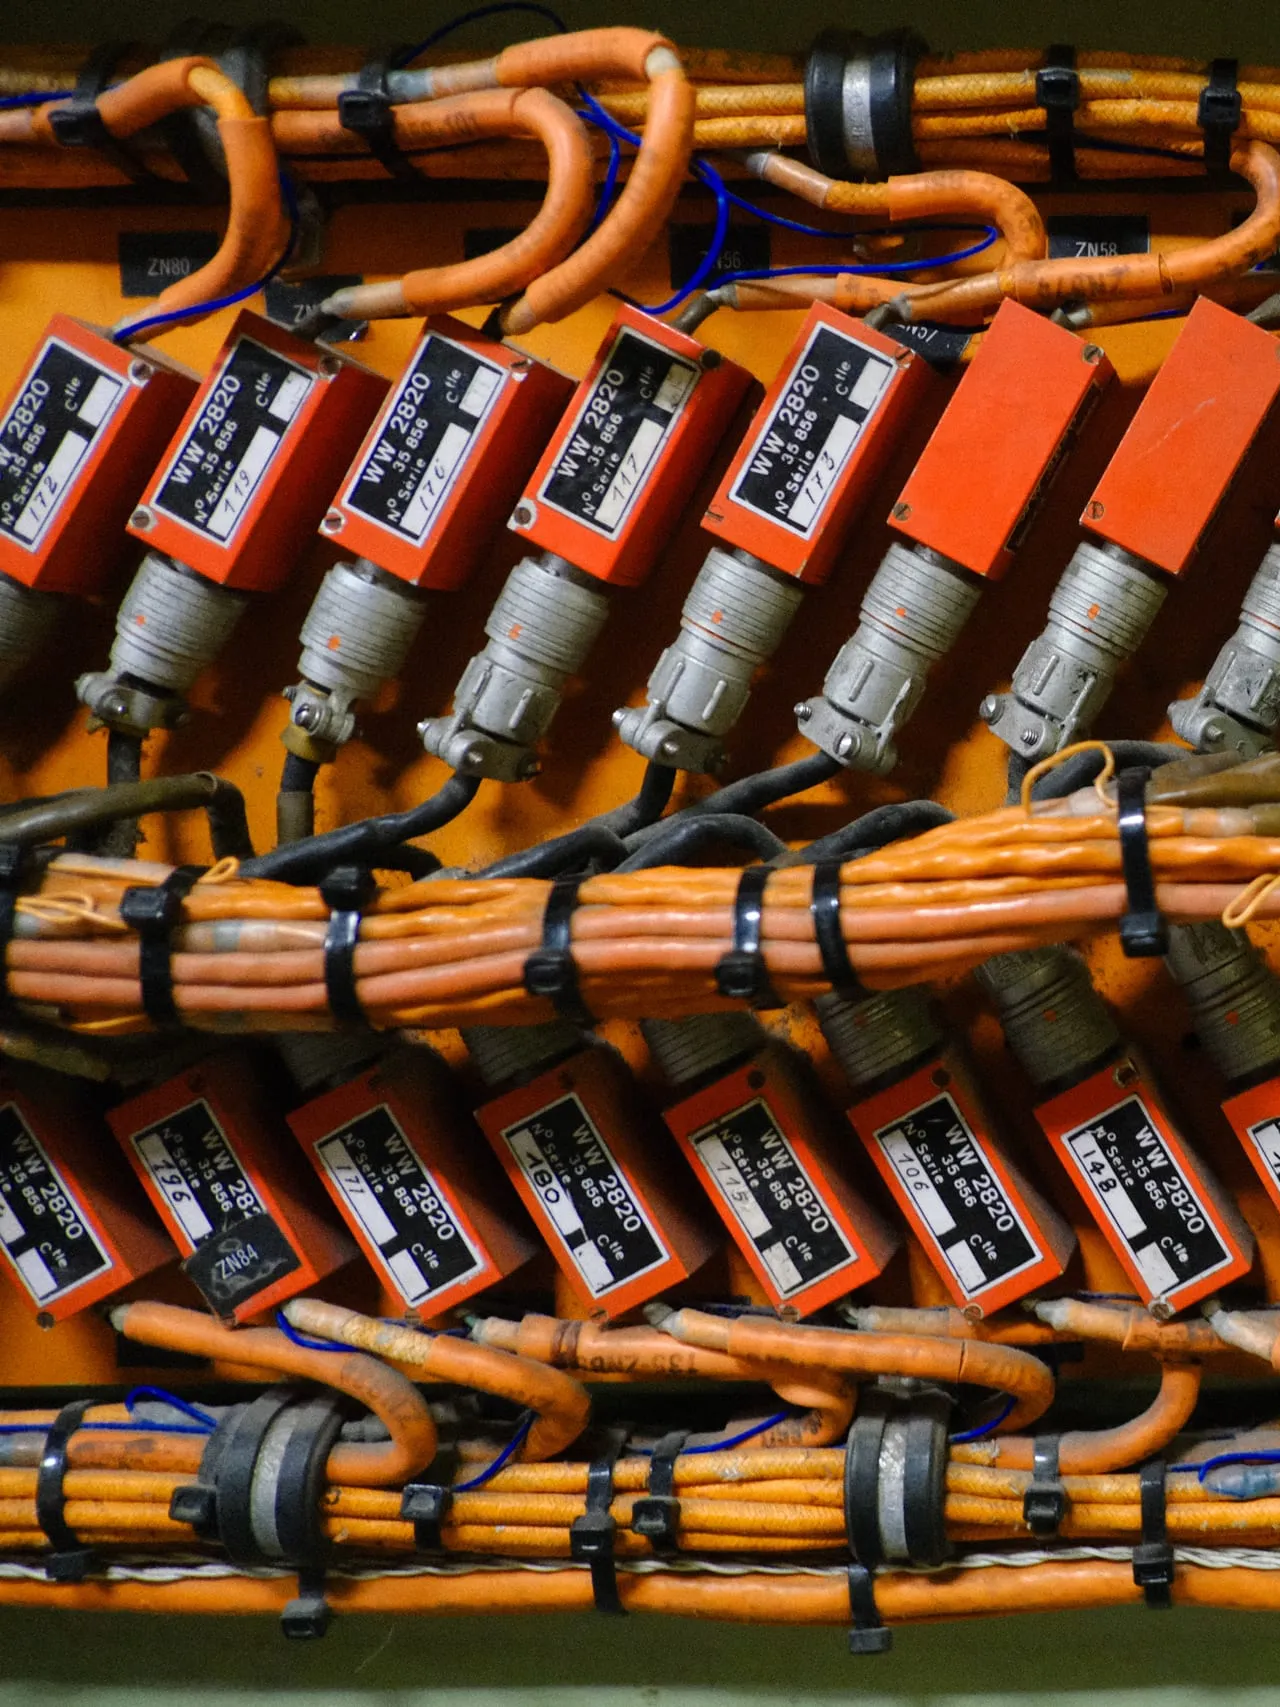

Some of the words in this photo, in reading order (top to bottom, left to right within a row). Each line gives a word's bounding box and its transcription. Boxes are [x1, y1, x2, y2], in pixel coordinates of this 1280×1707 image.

[147, 256, 191, 276] ZN80
[1076, 241, 1117, 257] ZN58
[7, 379, 49, 438] 2820
[170, 440, 204, 483] WW
[199, 375, 239, 435] 2820
[362, 438, 396, 482] WW
[389, 372, 429, 434] 2820
[557, 433, 590, 476] WW
[584, 369, 623, 429] 2820
[749, 431, 784, 475] WW
[778, 364, 819, 425] 2820
[8, 454, 26, 476] 35
[22, 423, 45, 453] 856
[200, 451, 218, 473] 35
[213, 420, 236, 450] 856
[392, 450, 410, 472] 35
[405, 418, 427, 448] 856
[587, 445, 605, 466] 35
[599, 413, 621, 443] 856
[780, 442, 799, 464] 35
[794, 409, 817, 440] 856
[612, 452, 637, 500] 117
[9, 1162, 27, 1182] 35
[22, 1185, 45, 1214] 856
[11, 1132, 45, 1173] WW
[39, 1182, 82, 1238] 2820
[152, 1158, 184, 1204] 196
[197, 1159, 216, 1179] 35
[210, 1181, 233, 1210] 856
[200, 1130, 233, 1170] WW
[227, 1179, 261, 1220] 282
[382, 1164, 400, 1184] 35
[394, 1186, 417, 1215] 856
[384, 1134, 418, 1175] WW
[411, 1183, 453, 1238] 2820
[527, 1153, 560, 1203] 180
[568, 1154, 587, 1175] 35
[581, 1177, 604, 1206] 856
[571, 1124, 605, 1165] WW
[598, 1174, 641, 1231] 2820
[717, 1161, 748, 1202] 115
[756, 1158, 774, 1178] 35
[768, 1180, 791, 1209] 856
[759, 1129, 792, 1169] WW
[786, 1177, 829, 1233] 2820
[898, 1153, 929, 1190] 106
[941, 1154, 960, 1174] 35
[954, 1177, 976, 1206] 856
[944, 1123, 978, 1165] WW
[971, 1174, 1013, 1230] 2820
[1082, 1149, 1117, 1192] 148
[1131, 1156, 1150, 1177] 35
[1144, 1179, 1167, 1208] 856
[1134, 1126, 1168, 1168] WW
[1161, 1176, 1205, 1232] 2820
[214, 1243, 260, 1281] ZN84
